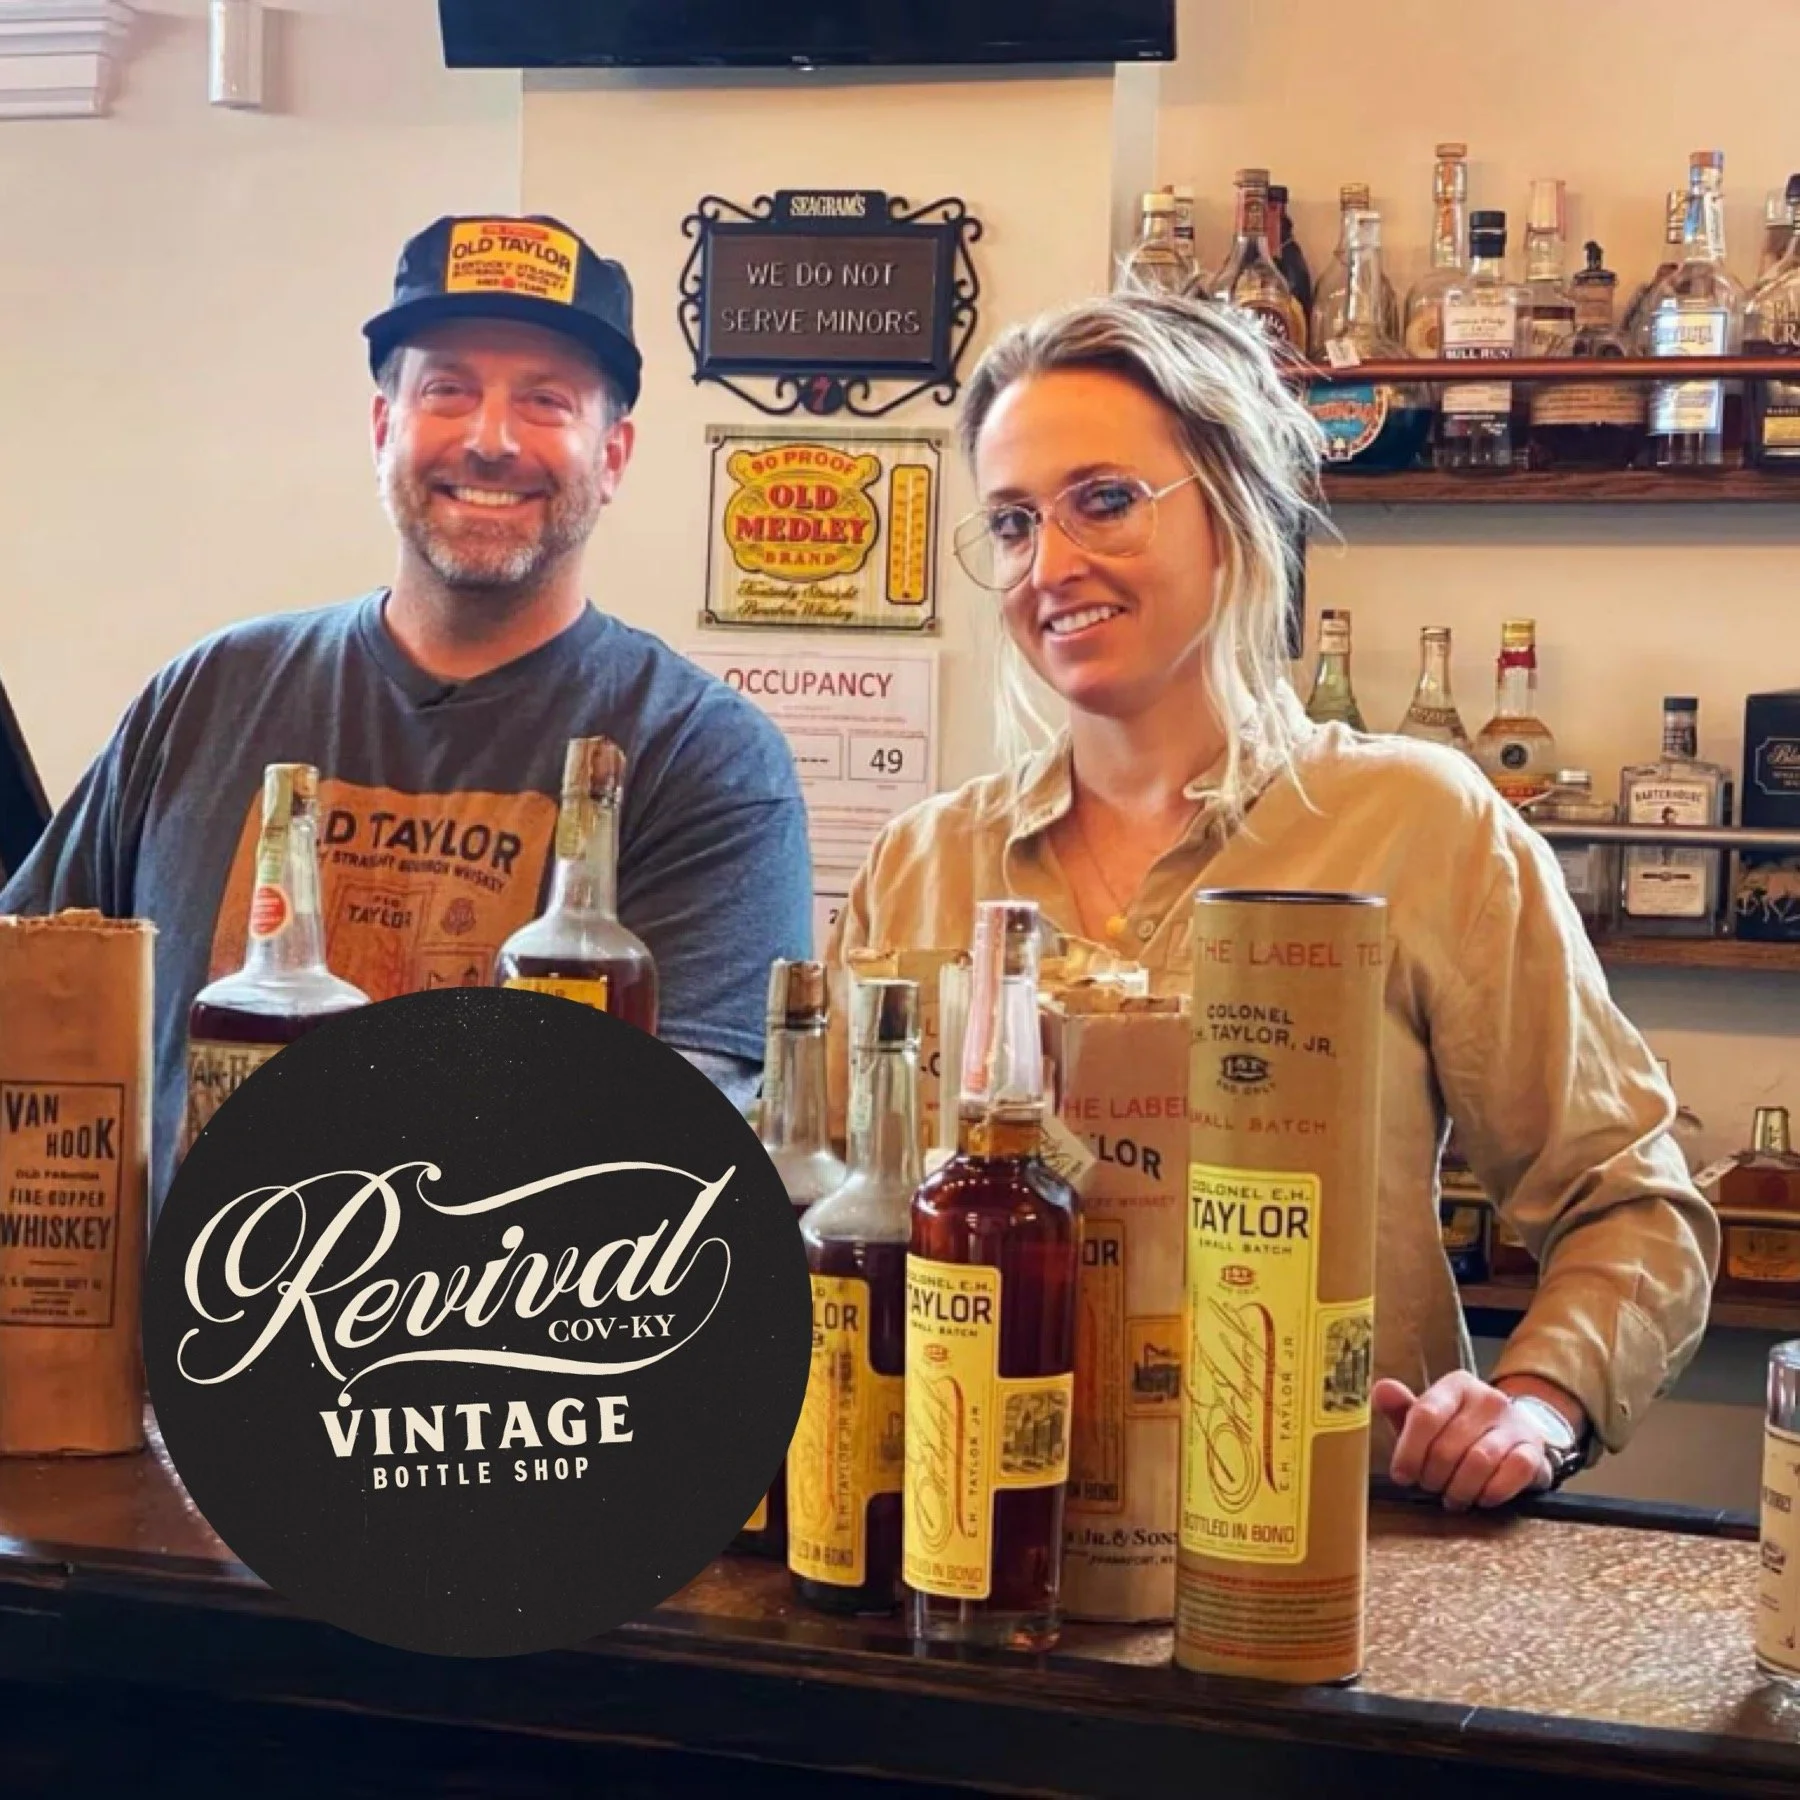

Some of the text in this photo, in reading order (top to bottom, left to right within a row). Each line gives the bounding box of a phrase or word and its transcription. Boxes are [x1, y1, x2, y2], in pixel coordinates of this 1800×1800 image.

[790, 194, 866, 216] SEAGRAM'S
[453, 236, 570, 274] OLD TAYLOR
[746, 261, 898, 288] WE DO NOT
[720, 309, 921, 335] SERVE MINORS
[811, 374, 831, 412] 7
[783, 451, 858, 474] PROOF
[768, 485, 838, 510] OLD
[735, 515, 871, 545] MEDLEY
[764, 551, 839, 566] BRAND
[724, 668, 893, 698] OCCUPANCY
[869, 748, 904, 774] 49
[370, 812, 522, 875] TAYLOR
[1249, 939, 1344, 969] LABEL
[1206, 1004, 1295, 1026] COLONEL
[1210, 1024, 1338, 1058] TAYLOR, JR.
[5, 1091, 60, 1134] VAN
[1062, 1098, 1101, 1121] HE
[46, 1117, 116, 1161] HOOK
[1248, 1116, 1328, 1135] BATCH
[1090, 1132, 1163, 1181] LOR
[1191, 1179, 1311, 1202] COLONEL E.H.
[0, 1212, 111, 1251] WHISKEY
[1191, 1197, 1310, 1240] TAYLOR
[1241, 1243, 1294, 1256] BATCH
[812, 1302, 858, 1332] LOR
[1232, 1522, 1248, 1541] IN
[1251, 1525, 1295, 1543] BOND
